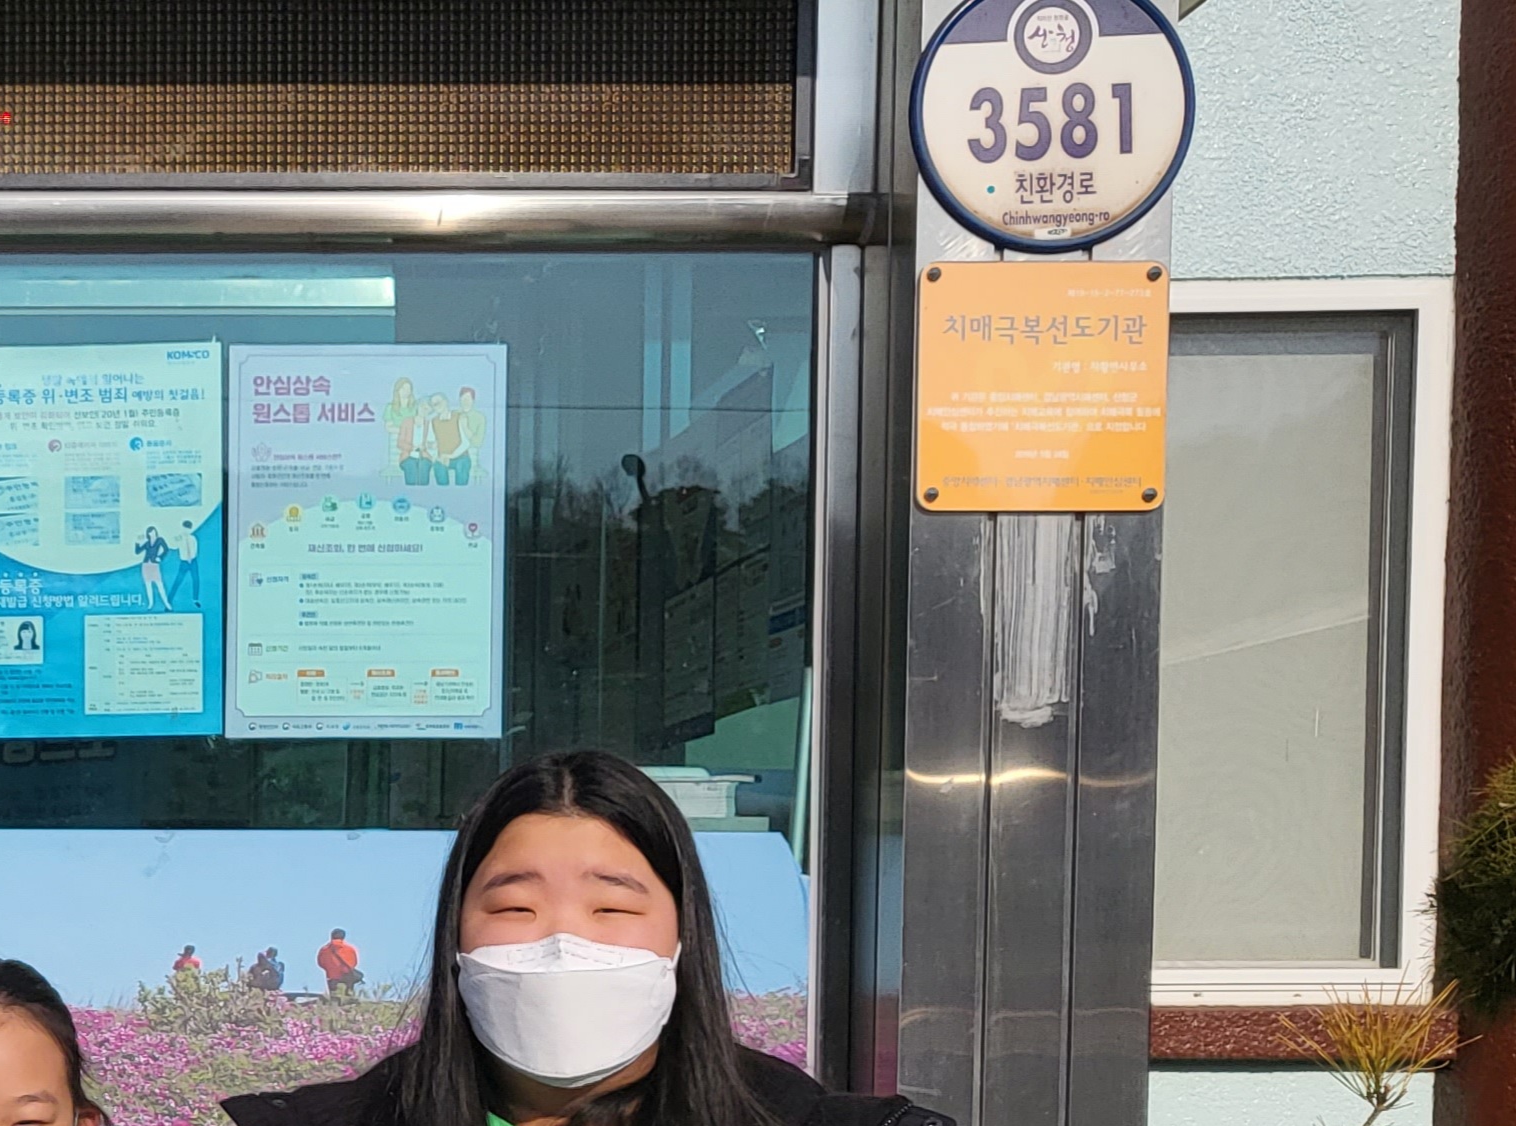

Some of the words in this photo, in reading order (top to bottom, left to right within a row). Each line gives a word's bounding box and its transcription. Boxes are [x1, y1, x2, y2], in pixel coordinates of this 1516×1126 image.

[968, 83, 1133, 163] 3581
[1015, 172, 1097, 204] 친환경로
[1002, 210, 1110, 228] Chinhwangyeong-ro
[942, 314, 1148, 345] 치매극복선도기관
[99, 387, 128, 404] 범죄
[252, 375, 331, 397] 안심상속
[252, 402, 311, 424] 원스톱
[317, 402, 376, 423] 서비스
